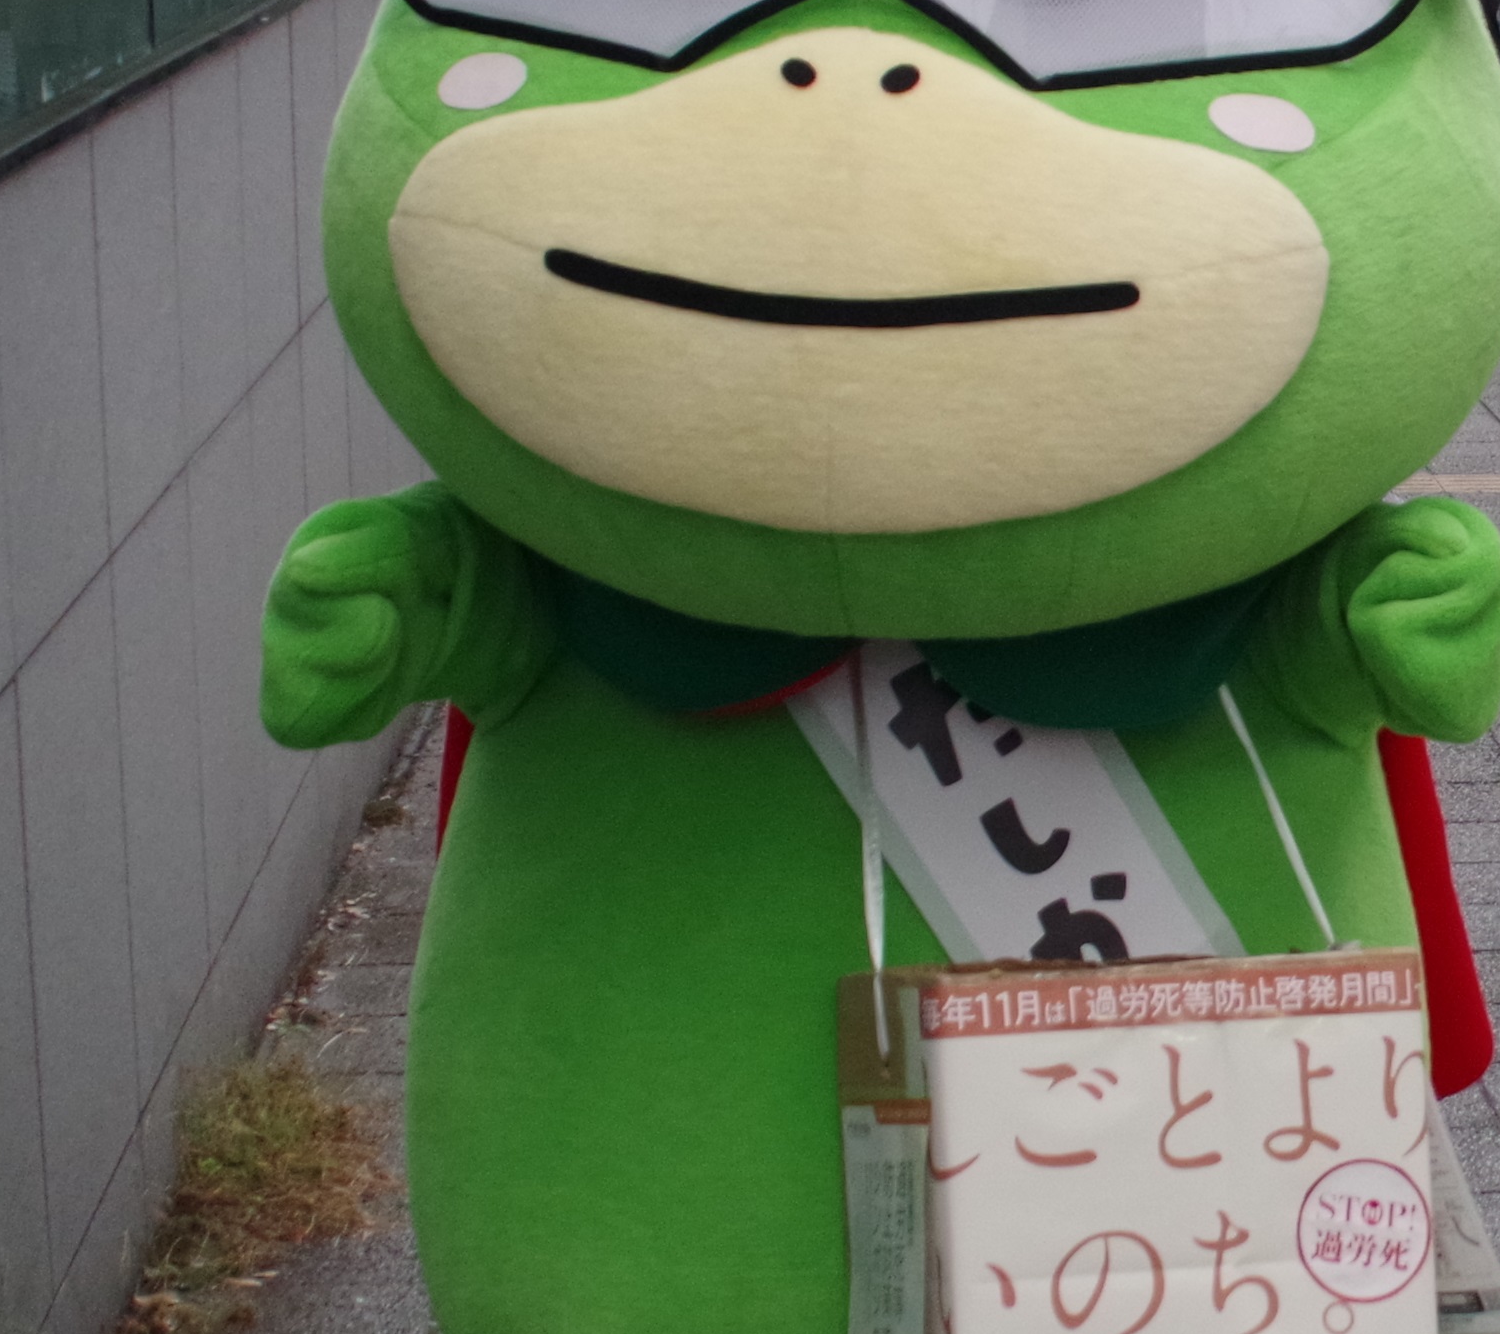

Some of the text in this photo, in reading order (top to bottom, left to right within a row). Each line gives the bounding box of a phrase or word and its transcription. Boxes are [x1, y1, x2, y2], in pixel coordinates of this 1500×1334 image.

[921, 968, 1423, 1033] 毎年11月は「過労死等防止啓発月間」
[1318, 1194, 1418, 1231] STOP!
[1310, 1229, 1409, 1271] 過労死
